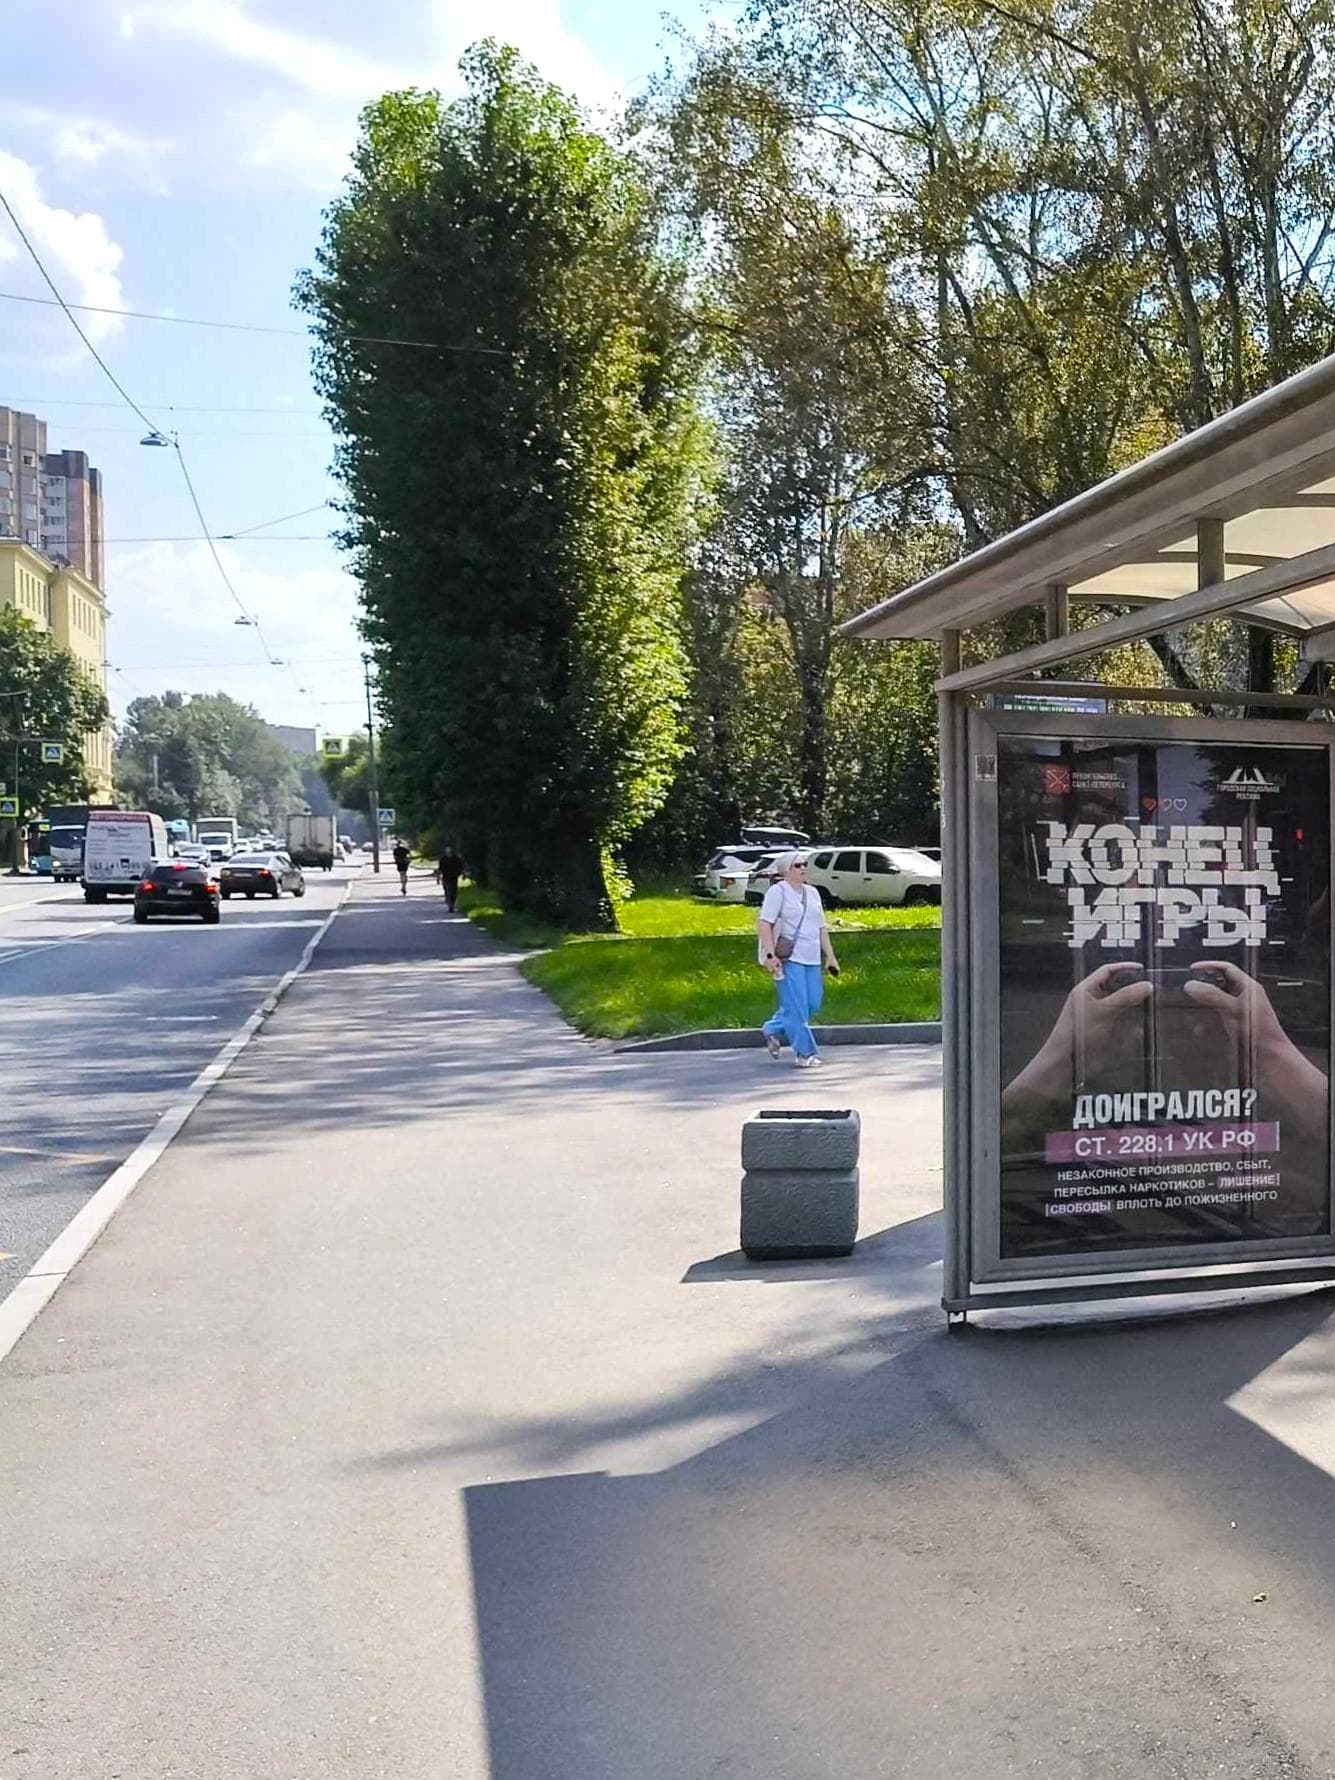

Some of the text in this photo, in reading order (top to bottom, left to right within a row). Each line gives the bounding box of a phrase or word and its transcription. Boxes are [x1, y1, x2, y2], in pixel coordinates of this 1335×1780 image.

[1046, 823, 1281, 895] КОНЕЦ
[1068, 887, 1267, 947] ИГРЫ
[1073, 1088, 1258, 1129] ДОИГРАЛСЯ?
[1075, 1129, 1256, 1157] СТ. 228.1 УК РФ
[1057, 1167, 1136, 1181] НЕЗАКОННОЕ
[1236, 1159, 1271, 1171] СБЫТ,
[1054, 1185, 1126, 1198] ПЕРЕСЫЛКА
[1129, 1180, 1206, 1193] НАРКОТИКОВ
[1220, 1174, 1275, 1187] ЛИШЕНИЕ
[1050, 1190, 1278, 1215] СВОБОДЫ ВПЛОТЬ ДО ПОЖИЗНЕННОГО
